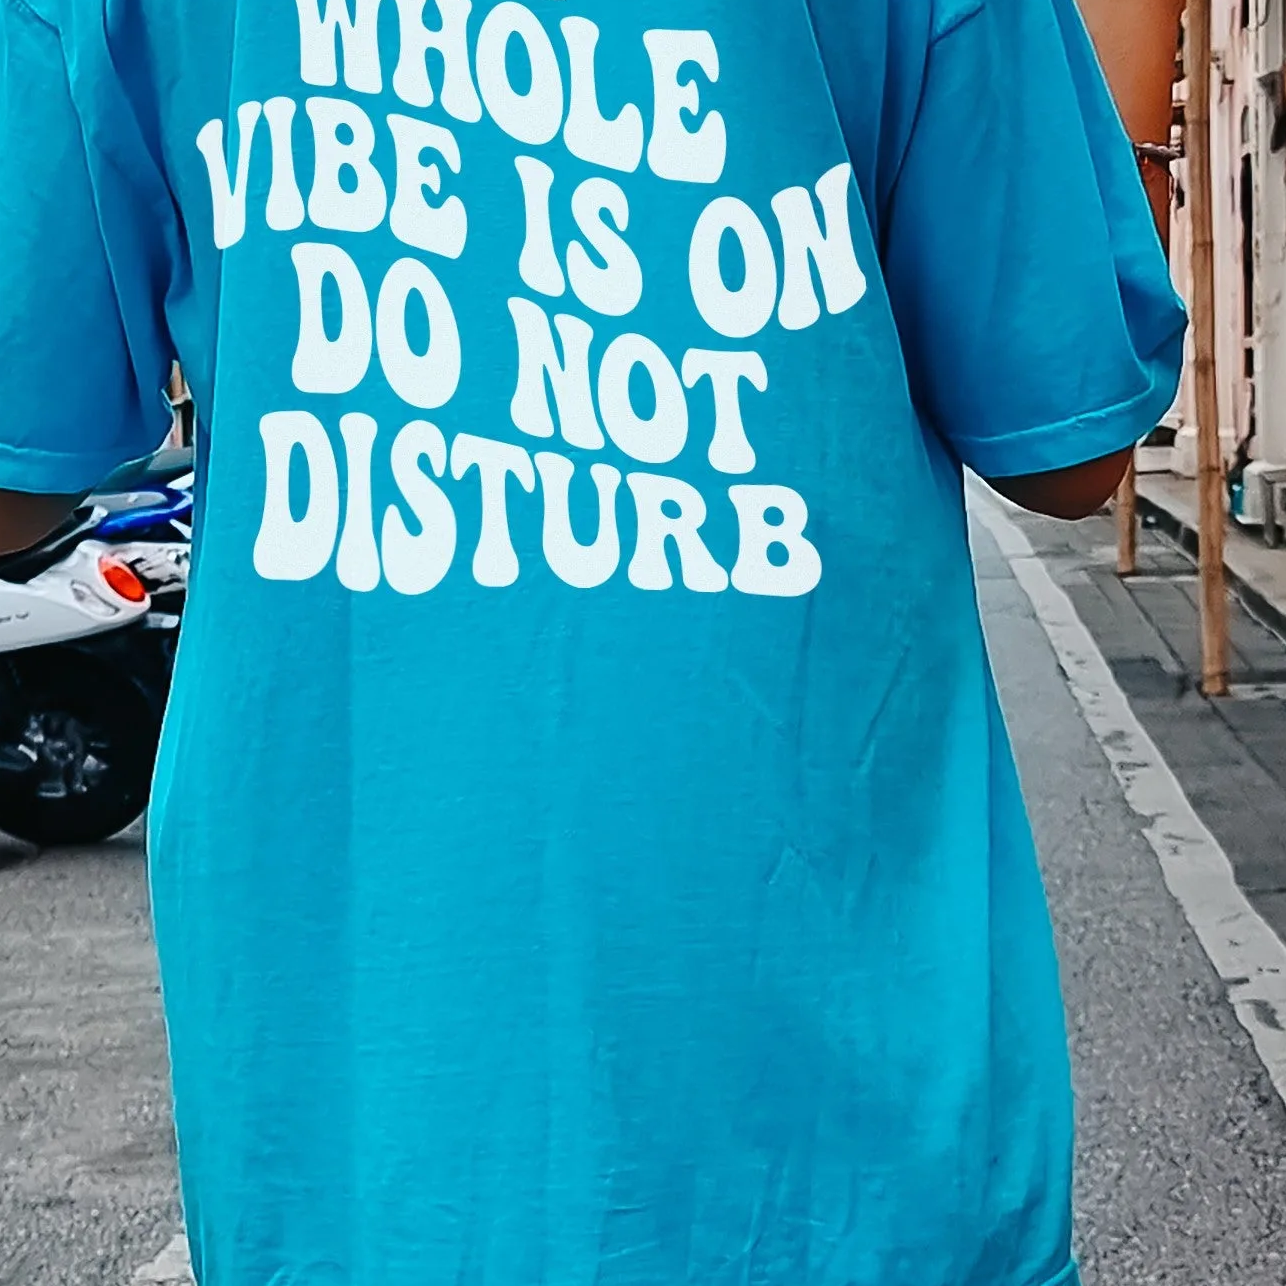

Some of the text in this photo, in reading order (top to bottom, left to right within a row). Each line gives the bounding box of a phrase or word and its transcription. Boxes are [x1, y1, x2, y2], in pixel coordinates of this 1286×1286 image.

[196, 96, 867, 338] VIBE IS ON
[291, 242, 767, 474] DO NOT
[253, 411, 822, 597] DISTURB
